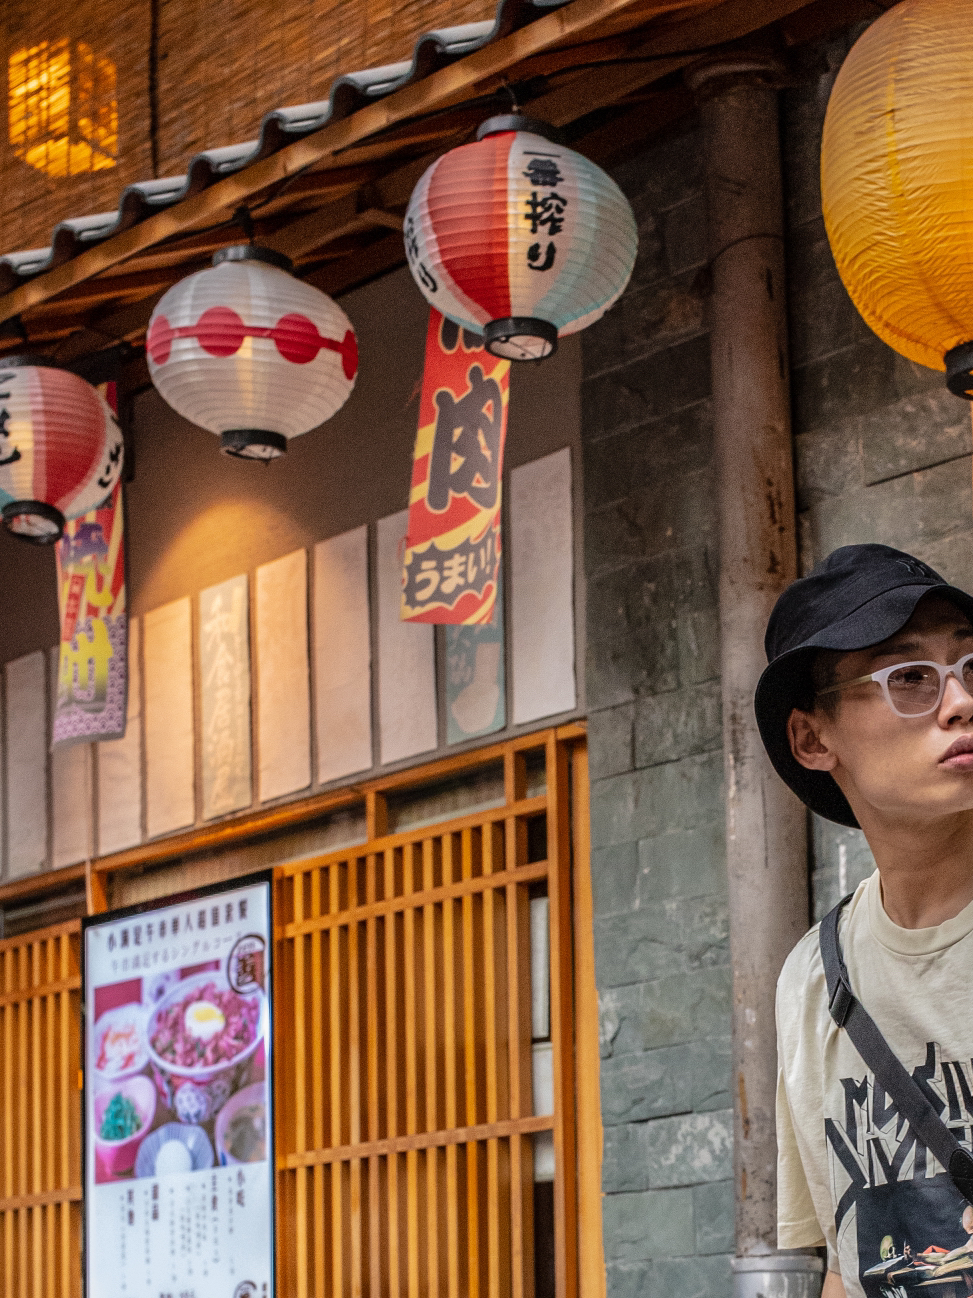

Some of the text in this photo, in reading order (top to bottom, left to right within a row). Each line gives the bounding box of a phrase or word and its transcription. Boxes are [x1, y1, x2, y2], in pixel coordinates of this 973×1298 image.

[522, 151, 568, 272] 一番搾り
[415, 538, 493, 599] うまい!
